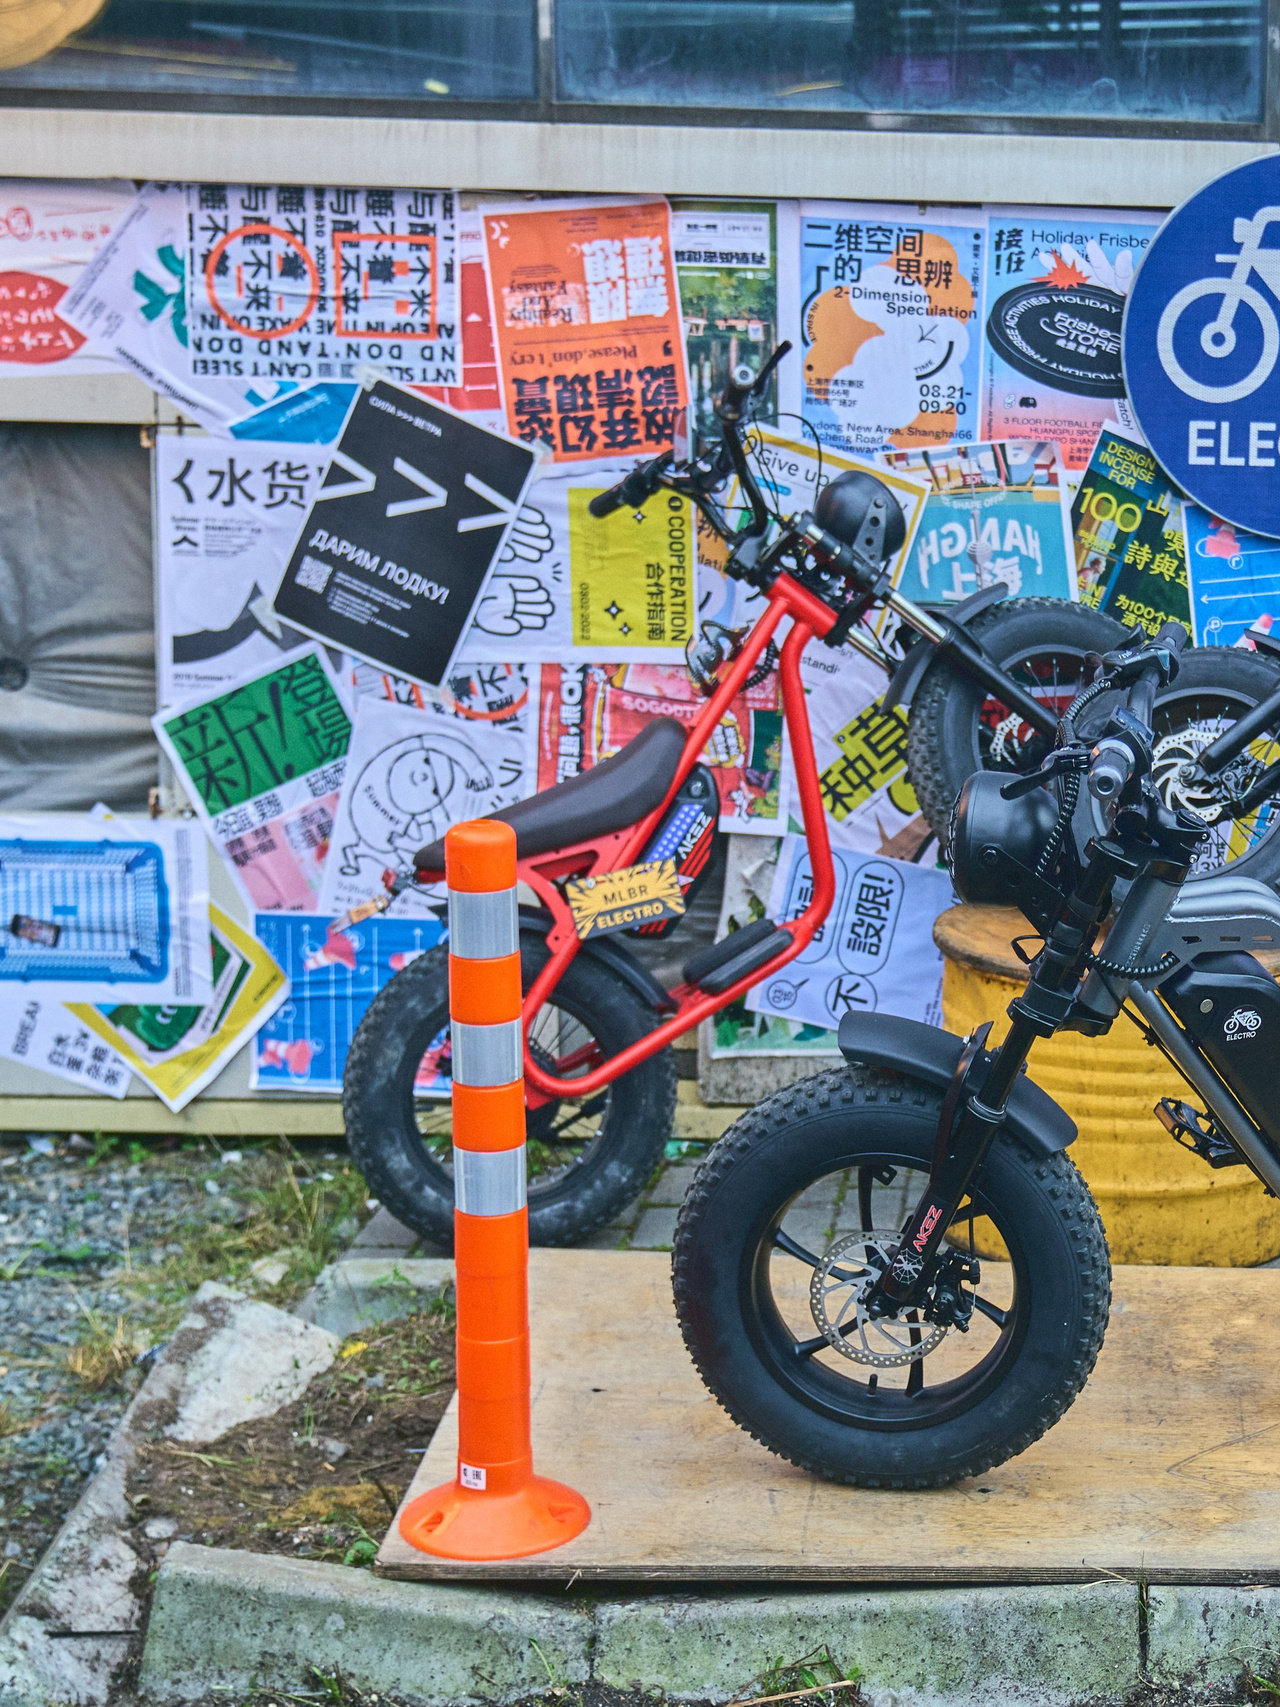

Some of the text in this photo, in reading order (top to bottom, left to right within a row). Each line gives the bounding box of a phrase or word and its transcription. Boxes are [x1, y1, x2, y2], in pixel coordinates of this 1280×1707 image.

[804, 223, 924, 257] 二维空间
[834, 254, 862, 283] 的
[894, 258, 953, 289] 思辨
[834, 286, 932, 305] 2-Dimension
[1051, 295, 1121, 315] HOLIDAY
[886, 301, 977, 319] Speculation
[913, 359, 935, 373] TIME
[919, 384, 972, 400] 08.21-
[368, 395, 398, 416] СИЛА
[919, 400, 967, 415] 09.20
[846, 423, 872, 434] New
[1012, 417, 1042, 426] FLOOR
[1044, 418, 1089, 427] FOOTBALL
[1029, 427, 1073, 436] HUANGPU
[855, 434, 884, 445] Road
[758, 448, 799, 478] Give
[1107, 441, 1157, 470] DESIGN
[1099, 451, 1156, 485] INCENSE
[1108, 469, 1137, 490] FOR
[1079, 487, 1143, 534] 100
[309, 529, 381, 573] ДАРИМ
[379, 560, 450, 605] ЛОДКУ!
[667, 515, 687, 643] COOPERATION
[645, 562, 667, 642] 合作指南
[364, 784, 402, 826] Summer
[604, 881, 649, 908] MLBR
[598, 902, 664, 929] ELECTRO
[1226, 1030, 1257, 1042] ELECTRO
